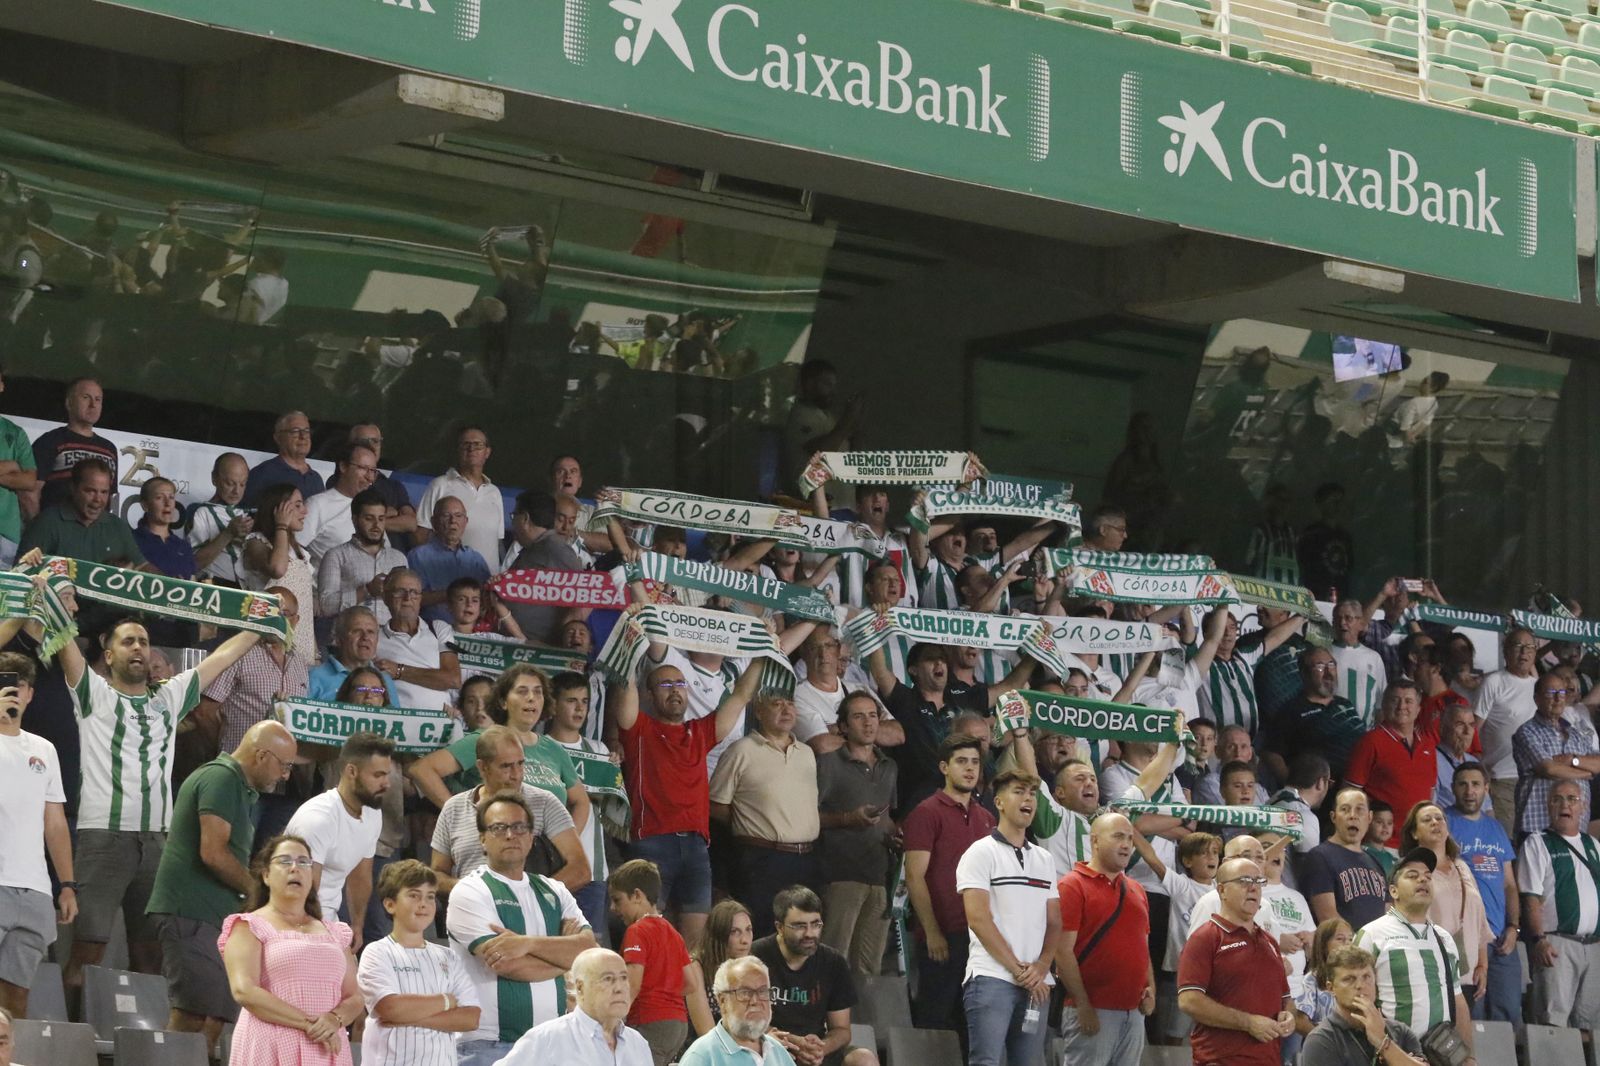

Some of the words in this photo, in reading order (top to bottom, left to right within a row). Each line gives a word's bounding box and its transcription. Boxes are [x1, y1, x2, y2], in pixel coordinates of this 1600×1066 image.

[707, 4, 1011, 137] CaixaBank
[1242, 117, 1504, 236] CaixaBank
[843, 454, 892, 467] ¡HEMOS
[895, 455, 948, 468] VUELTO!
[857, 467, 884, 476] SOMOS
[886, 468, 896, 476] DE
[640, 492, 751, 526] CÓRDOBA
[534, 570, 604, 587] MUJER
[761, 578, 787, 600] CF
[1123, 577, 1187, 593] CÓRDOBA
[505, 582, 626, 605] CORDOBESA
[661, 609, 727, 632] CÓRDOBA
[729, 621, 747, 634] CF
[898, 610, 989, 638] CÓRDOBA
[1051, 620, 1152, 642] ÓRDOBA
[673, 629, 705, 640] DESDE
[706, 633, 730, 645] 1954
[457, 653, 482, 663] ESDE
[512, 648, 536, 662] CF
[1035, 699, 1138, 732] CÓRDOBA
[1143, 714, 1171, 733] CF
